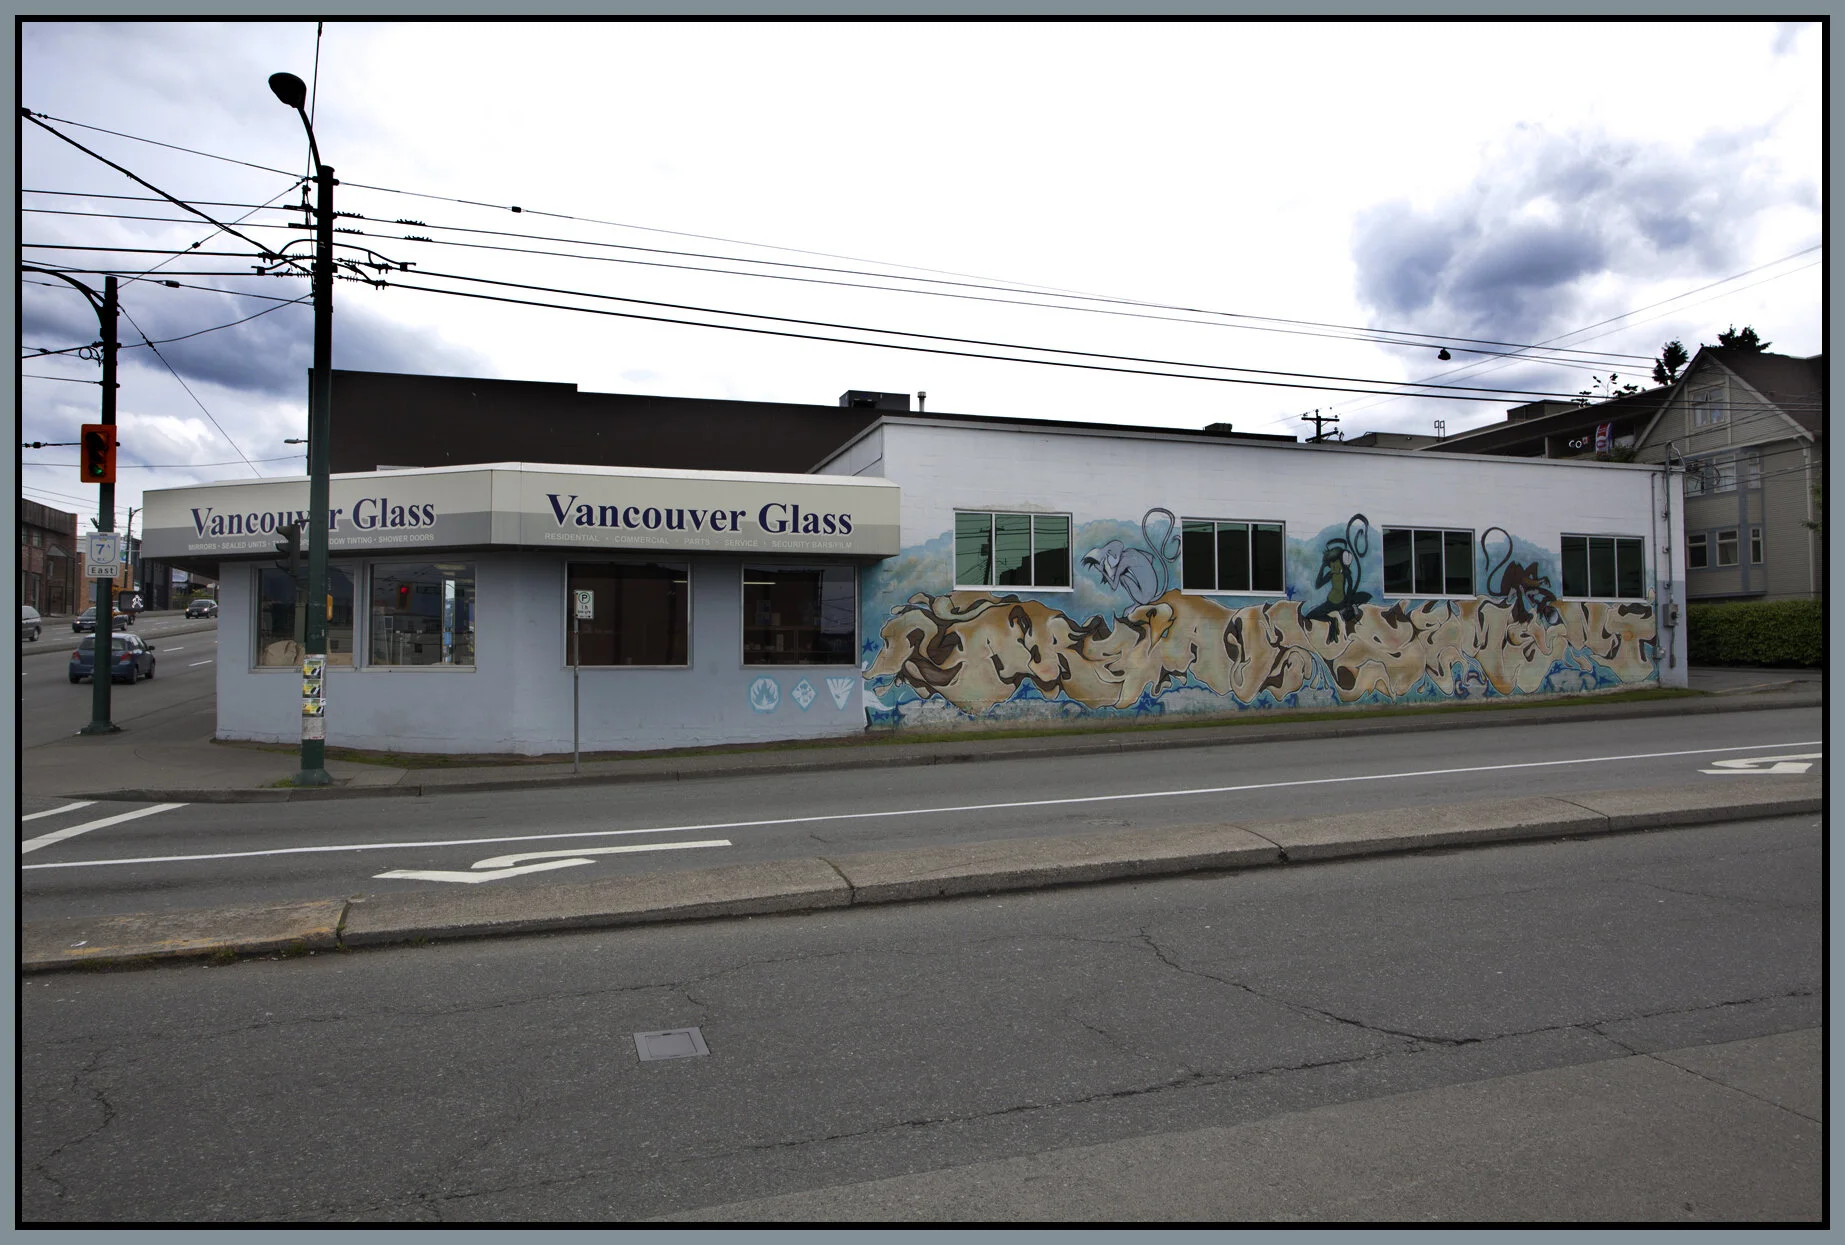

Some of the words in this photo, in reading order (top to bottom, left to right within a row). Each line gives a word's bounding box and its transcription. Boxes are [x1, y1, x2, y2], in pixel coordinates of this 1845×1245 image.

[191, 507, 343, 536] Vancouvr
[352, 497, 437, 531] Glass
[546, 493, 747, 533] Vancouver
[757, 502, 853, 535] Glass
[346, 536, 373, 544] TINTING
[378, 535, 408, 543] SHOWER
[409, 533, 434, 542] DOORS
[544, 532, 600, 542] RESIDENTIAL
[614, 535, 669, 544] COMMERCIAL
[684, 537, 711, 546] PARTS
[724, 539, 758, 547] SERVICE
[771, 540, 810, 549] SECURITY
[188, 543, 217, 551] MIRRORS
[221, 542, 247, 550] SEALED
[247, 541, 268, 549] UNITS
[91, 566, 114, 574] East
[581, 594, 588, 602] P
